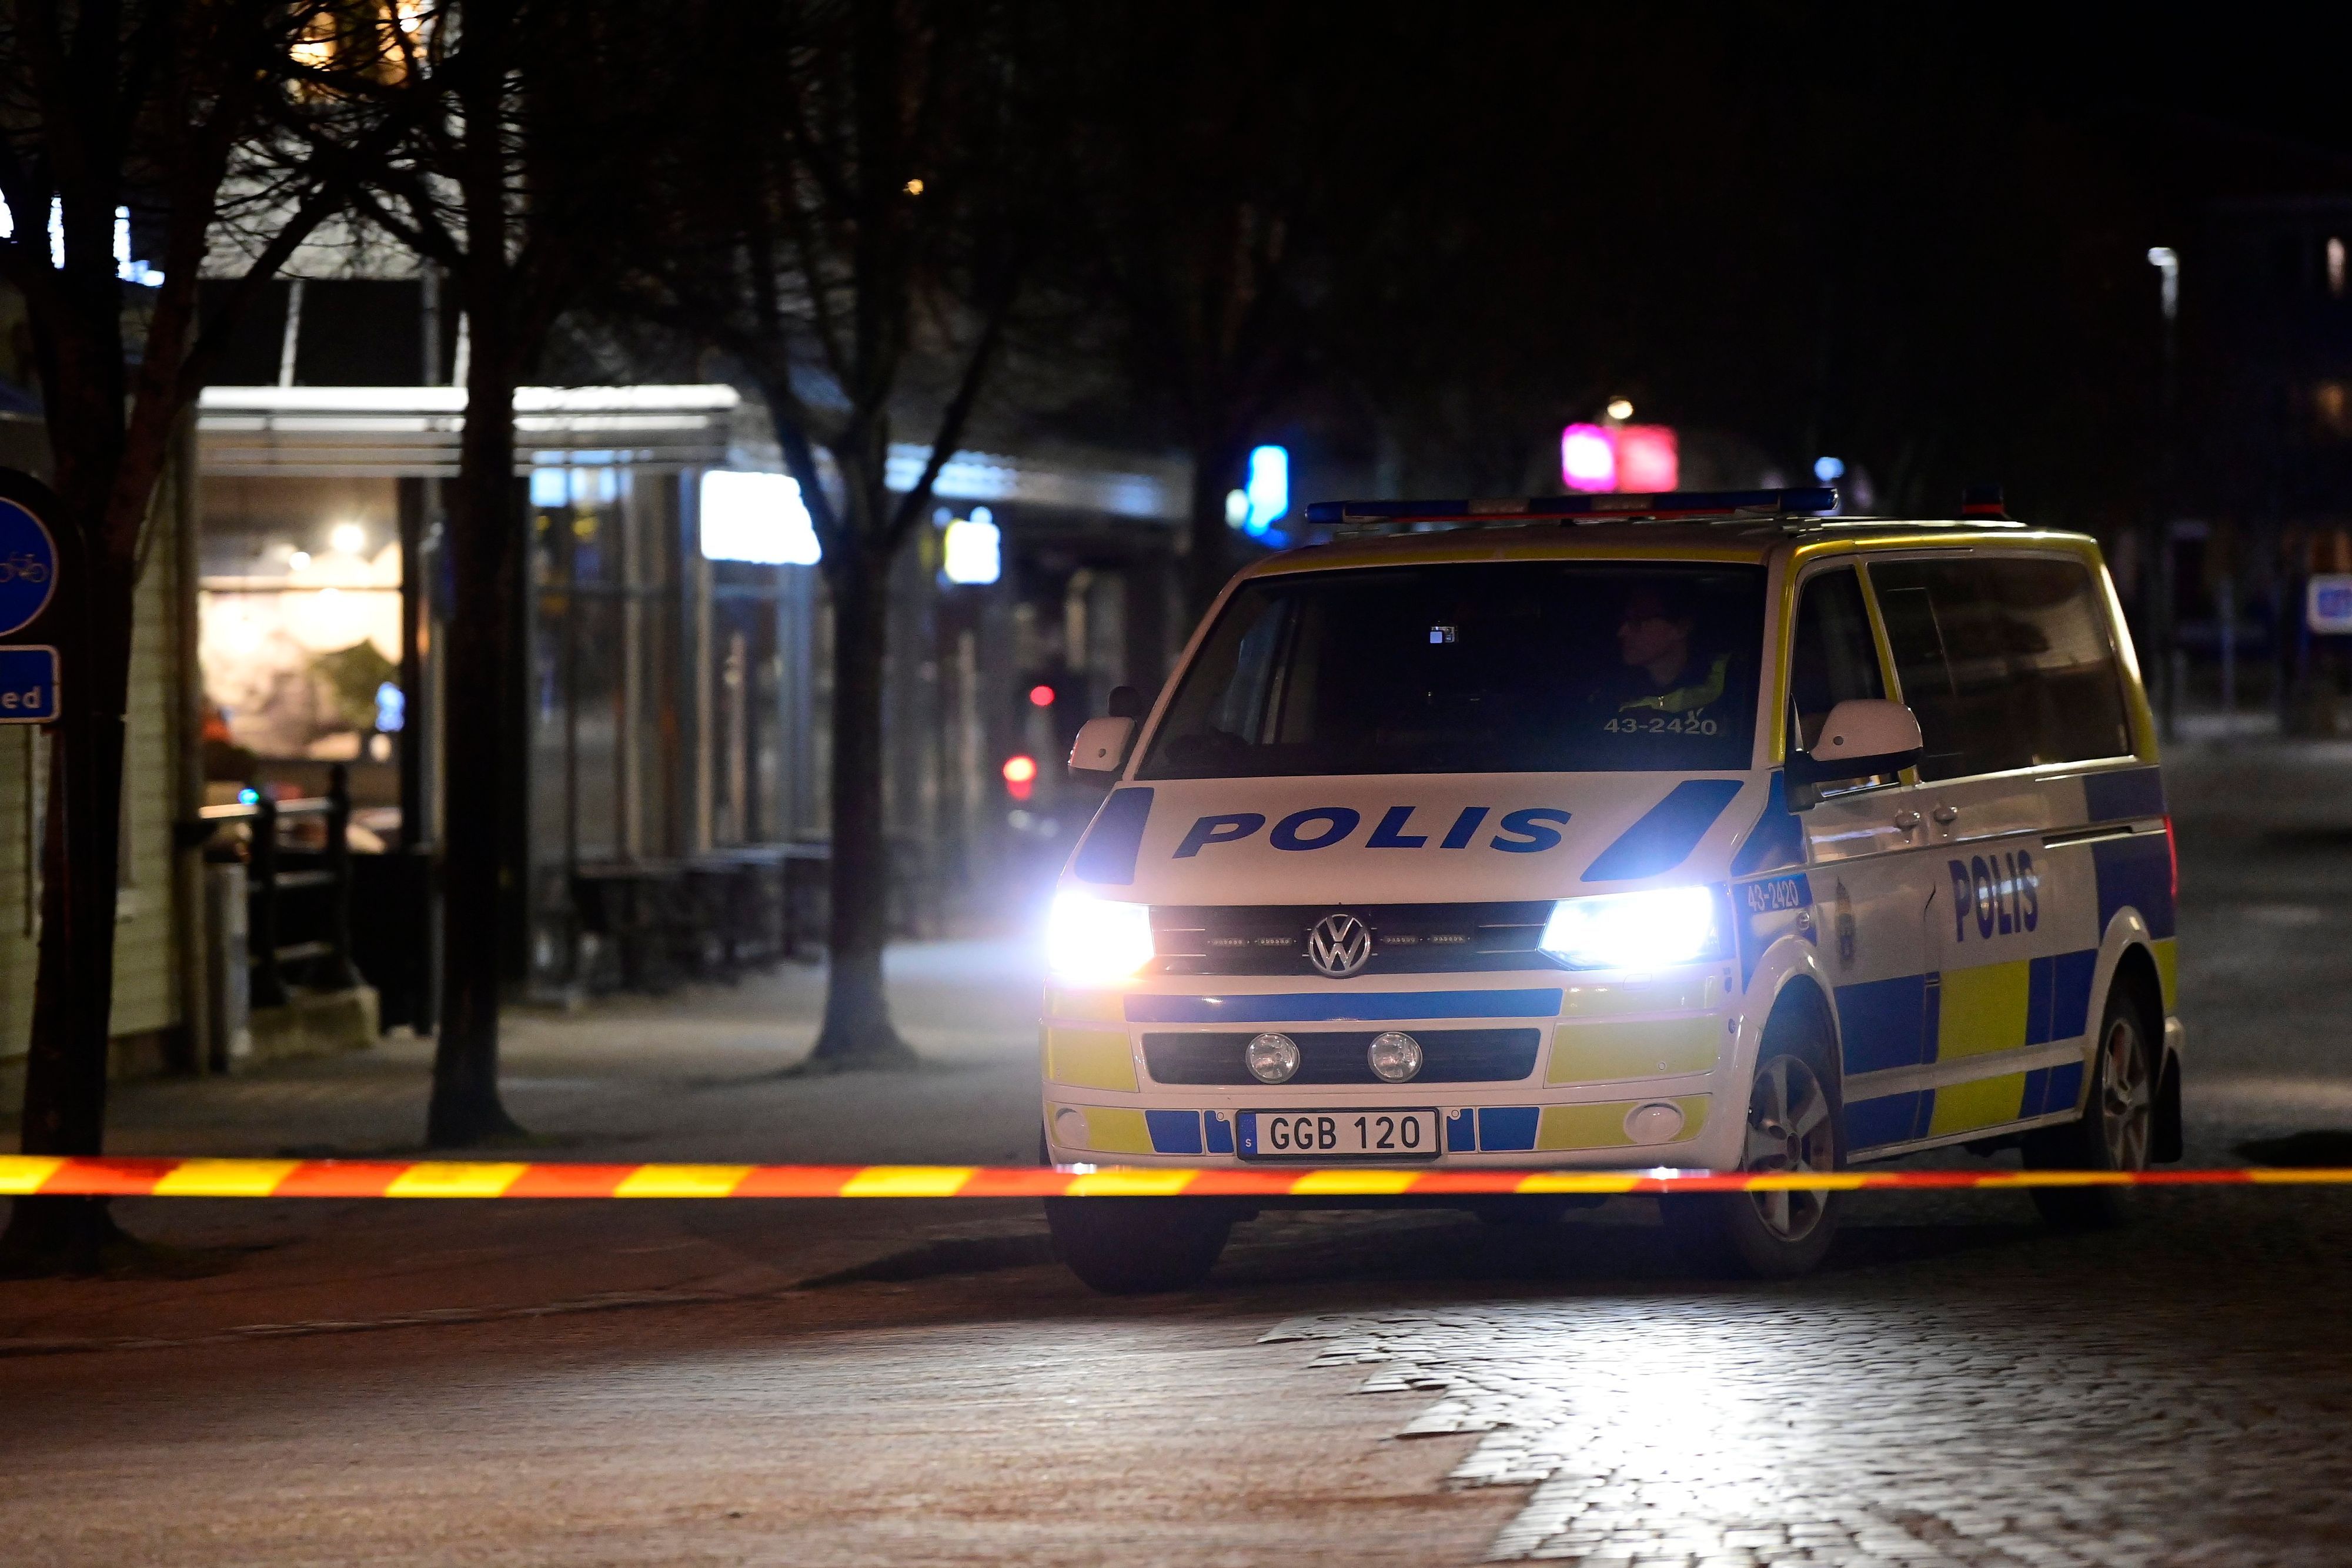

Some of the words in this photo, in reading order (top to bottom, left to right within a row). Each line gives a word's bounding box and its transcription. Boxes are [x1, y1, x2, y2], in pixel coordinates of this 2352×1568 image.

[1603, 718, 1718, 735] 43-2420
[1172, 806, 1571, 859] POLIS
[1748, 879, 1799, 911] 43-2420
[1948, 850, 2039, 942] POLIS
[1245, 1138, 1252, 1147] S
[1271, 1116, 1336, 1149] GGB
[1354, 1116, 1419, 1148] 120
